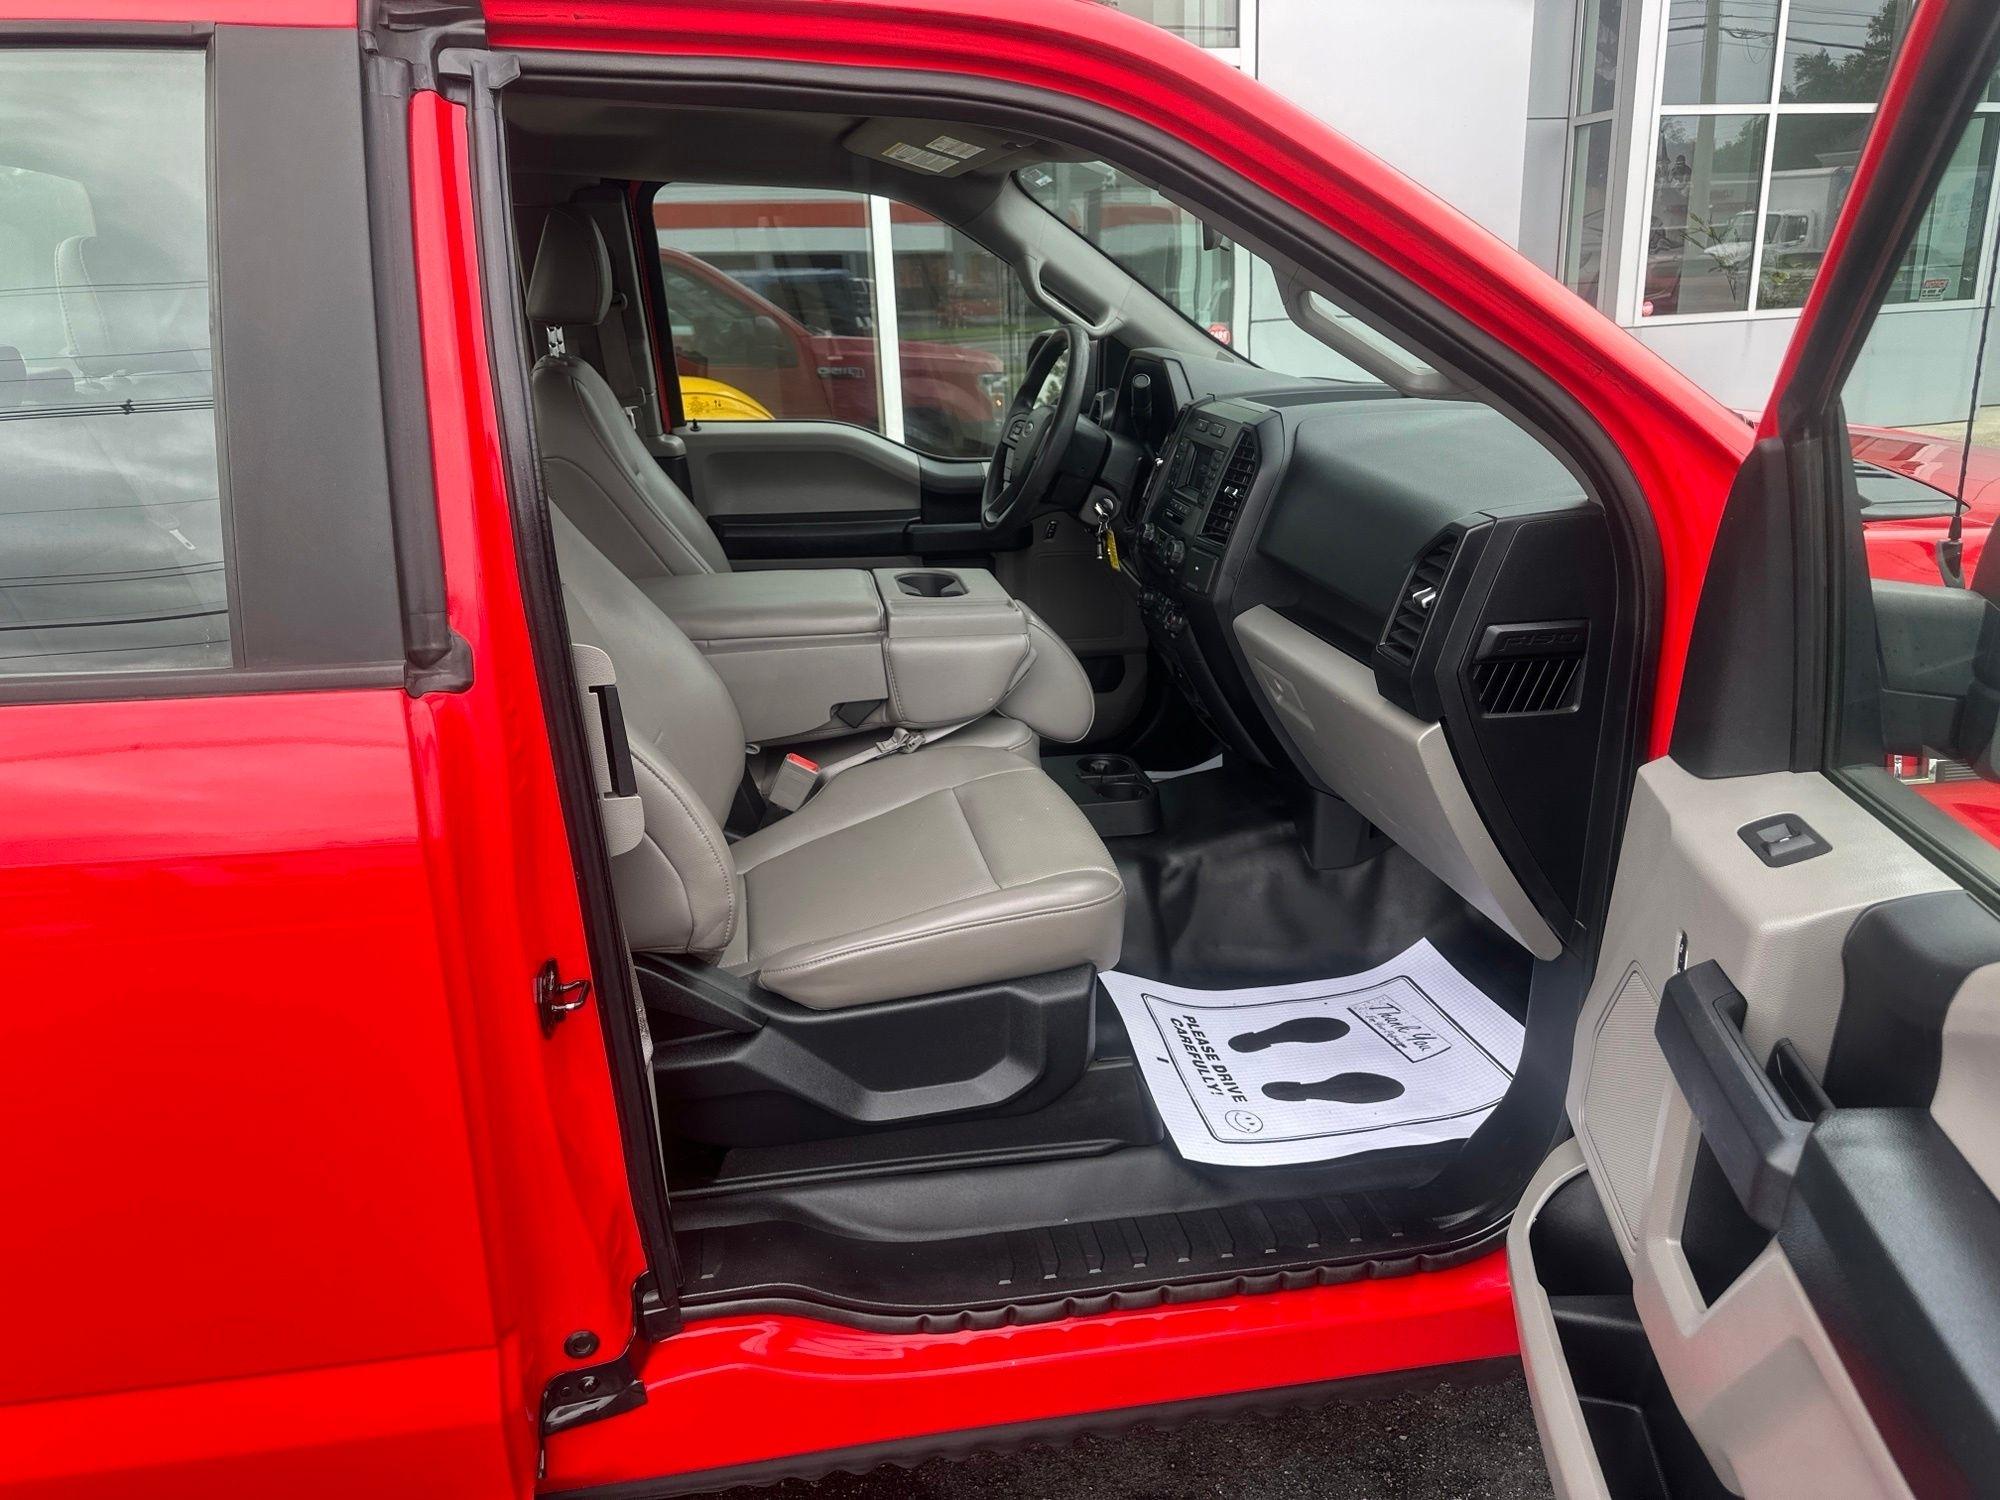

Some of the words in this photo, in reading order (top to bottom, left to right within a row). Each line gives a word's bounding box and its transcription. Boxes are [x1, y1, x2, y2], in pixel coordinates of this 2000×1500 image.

[1170, 1017, 1225, 1096] CAREFULLY!
[1182, 1014, 1221, 1061] PLEASE
[1211, 1064, 1248, 1102] DRIVE
[1368, 1002, 1422, 1034] Thank
[1407, 1033, 1437, 1051] You
